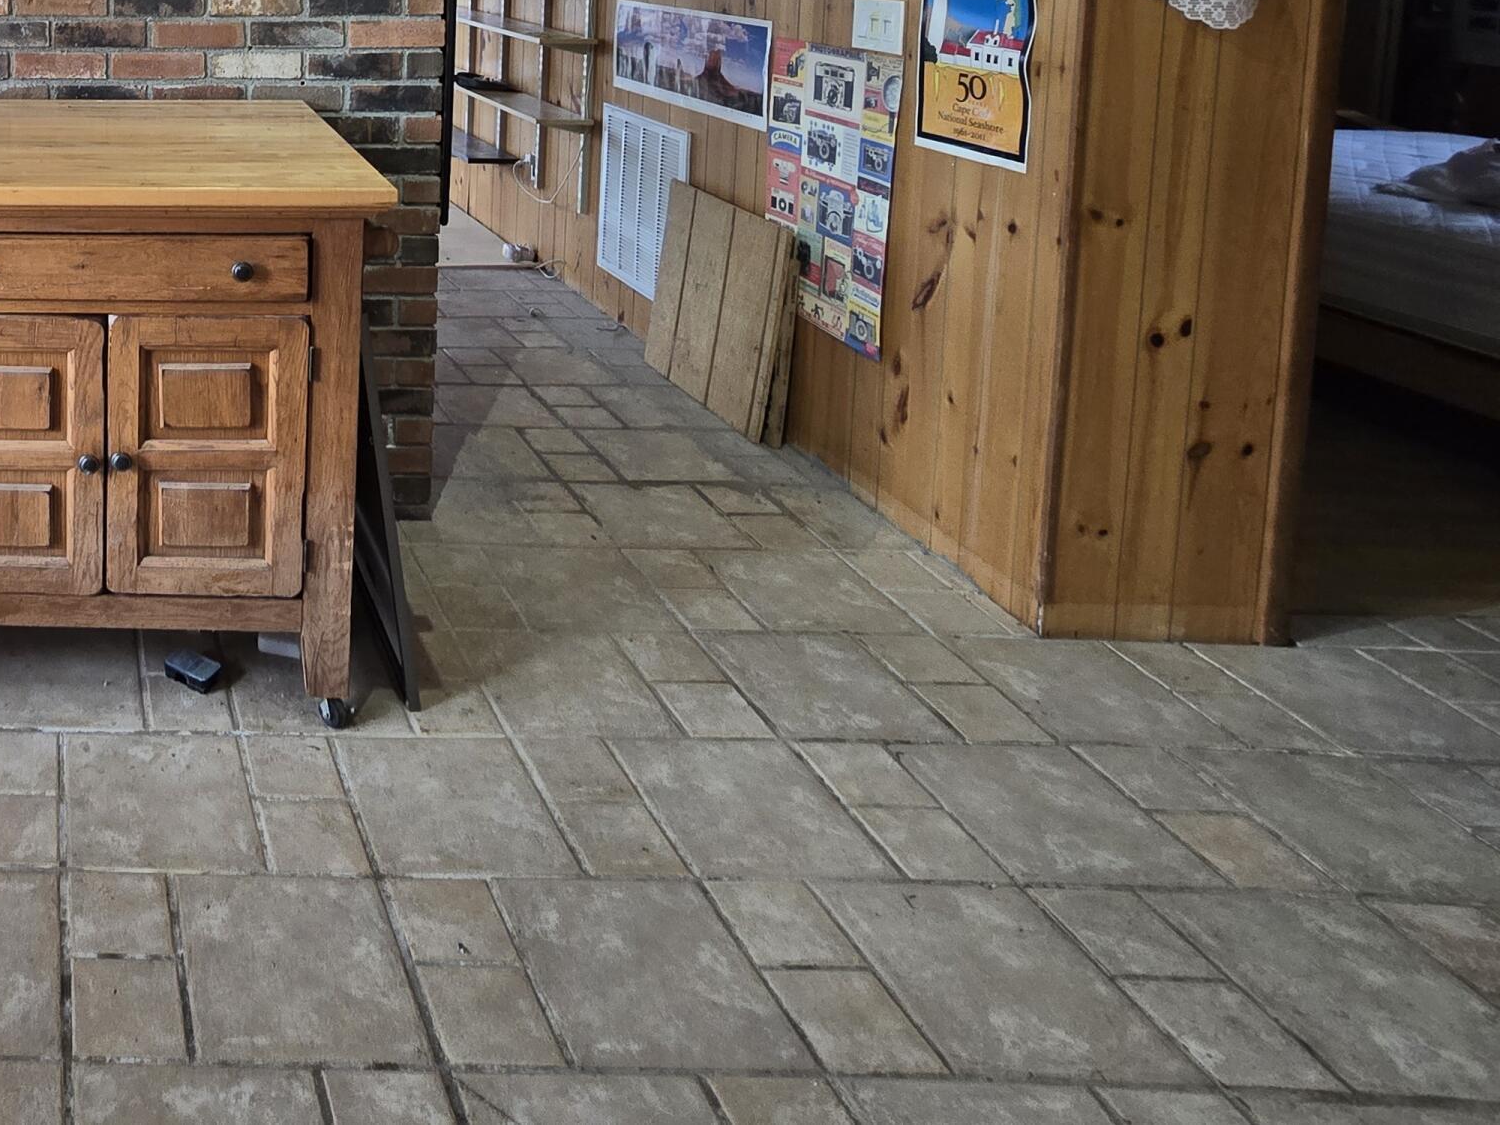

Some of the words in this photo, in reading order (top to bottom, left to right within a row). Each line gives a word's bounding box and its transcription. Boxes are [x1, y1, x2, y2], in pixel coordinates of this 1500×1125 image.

[955, 73, 987, 103] 50
[952, 103, 971, 116] Cape
[938, 111, 968, 125] National
[969, 117, 1004, 134] Seashore
[773, 131, 798, 144] CAMERA
[953, 126, 986, 141] 1961-2011
